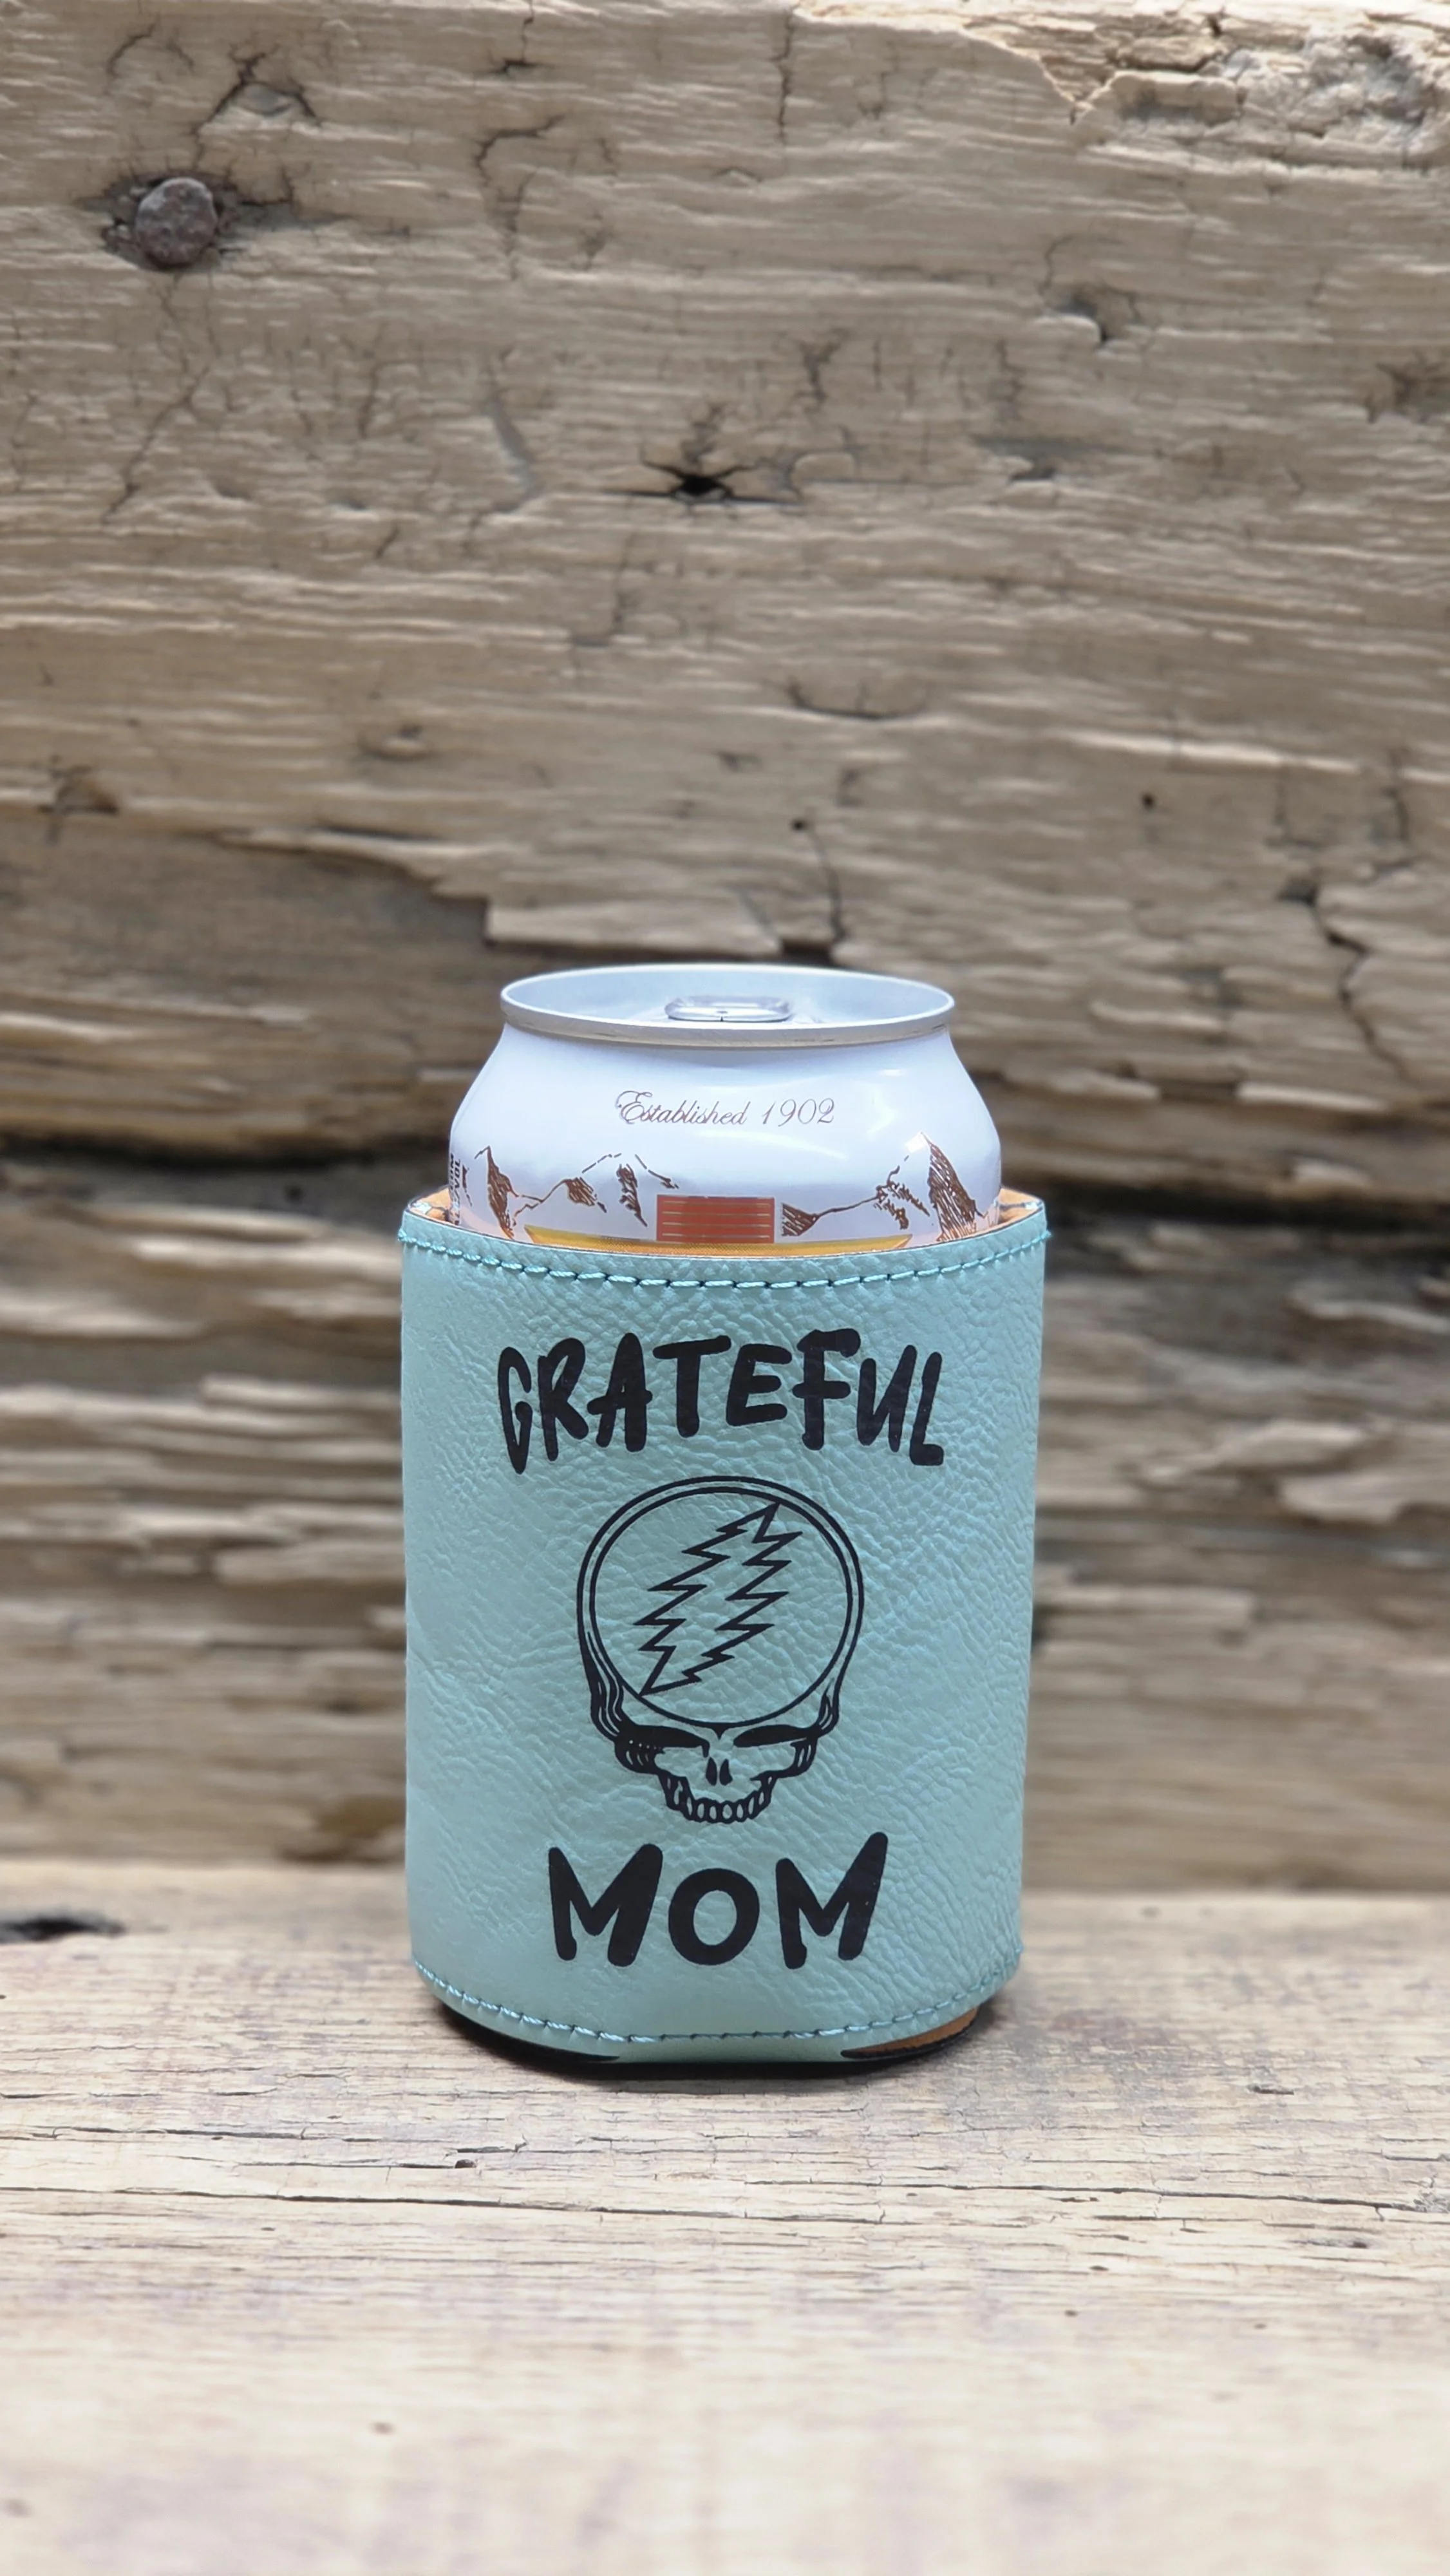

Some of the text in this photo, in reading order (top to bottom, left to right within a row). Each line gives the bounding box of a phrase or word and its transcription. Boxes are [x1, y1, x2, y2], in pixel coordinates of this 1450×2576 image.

[615, 1090, 835, 1127] Established 1902
[496, 1327, 945, 1475] GRATEFUL
[547, 1831, 889, 1971] MOM
